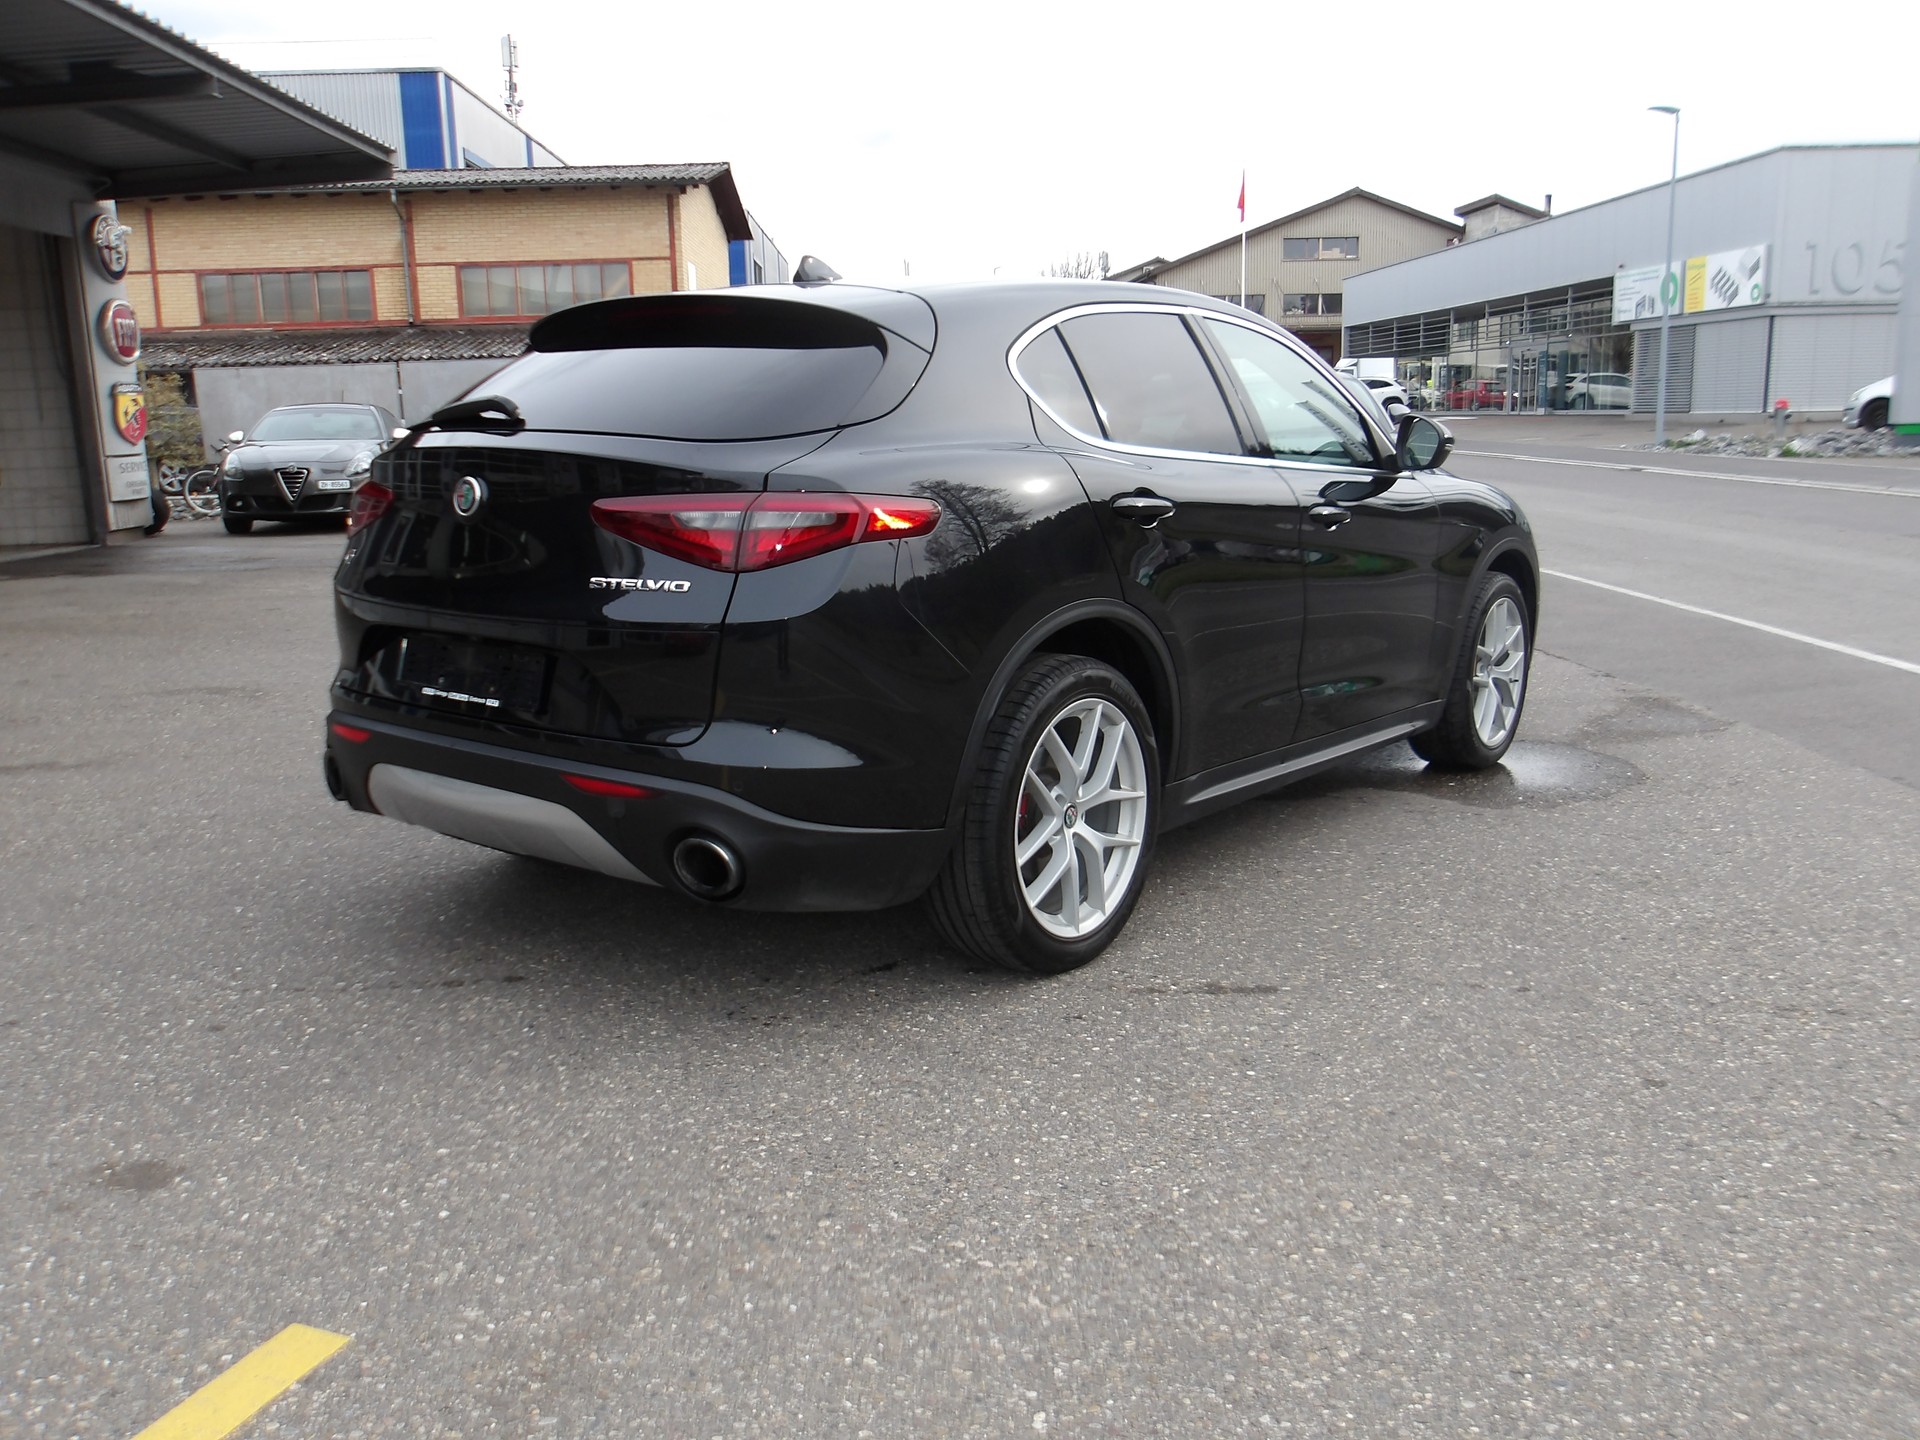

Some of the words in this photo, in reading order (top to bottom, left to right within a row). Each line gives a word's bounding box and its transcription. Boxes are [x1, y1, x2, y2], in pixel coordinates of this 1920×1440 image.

[1806, 239, 1907, 296] 105
[116, 318, 136, 347] FIAT
[118, 384, 143, 393] ABARTH
[589, 576, 691, 593] STELVIO
